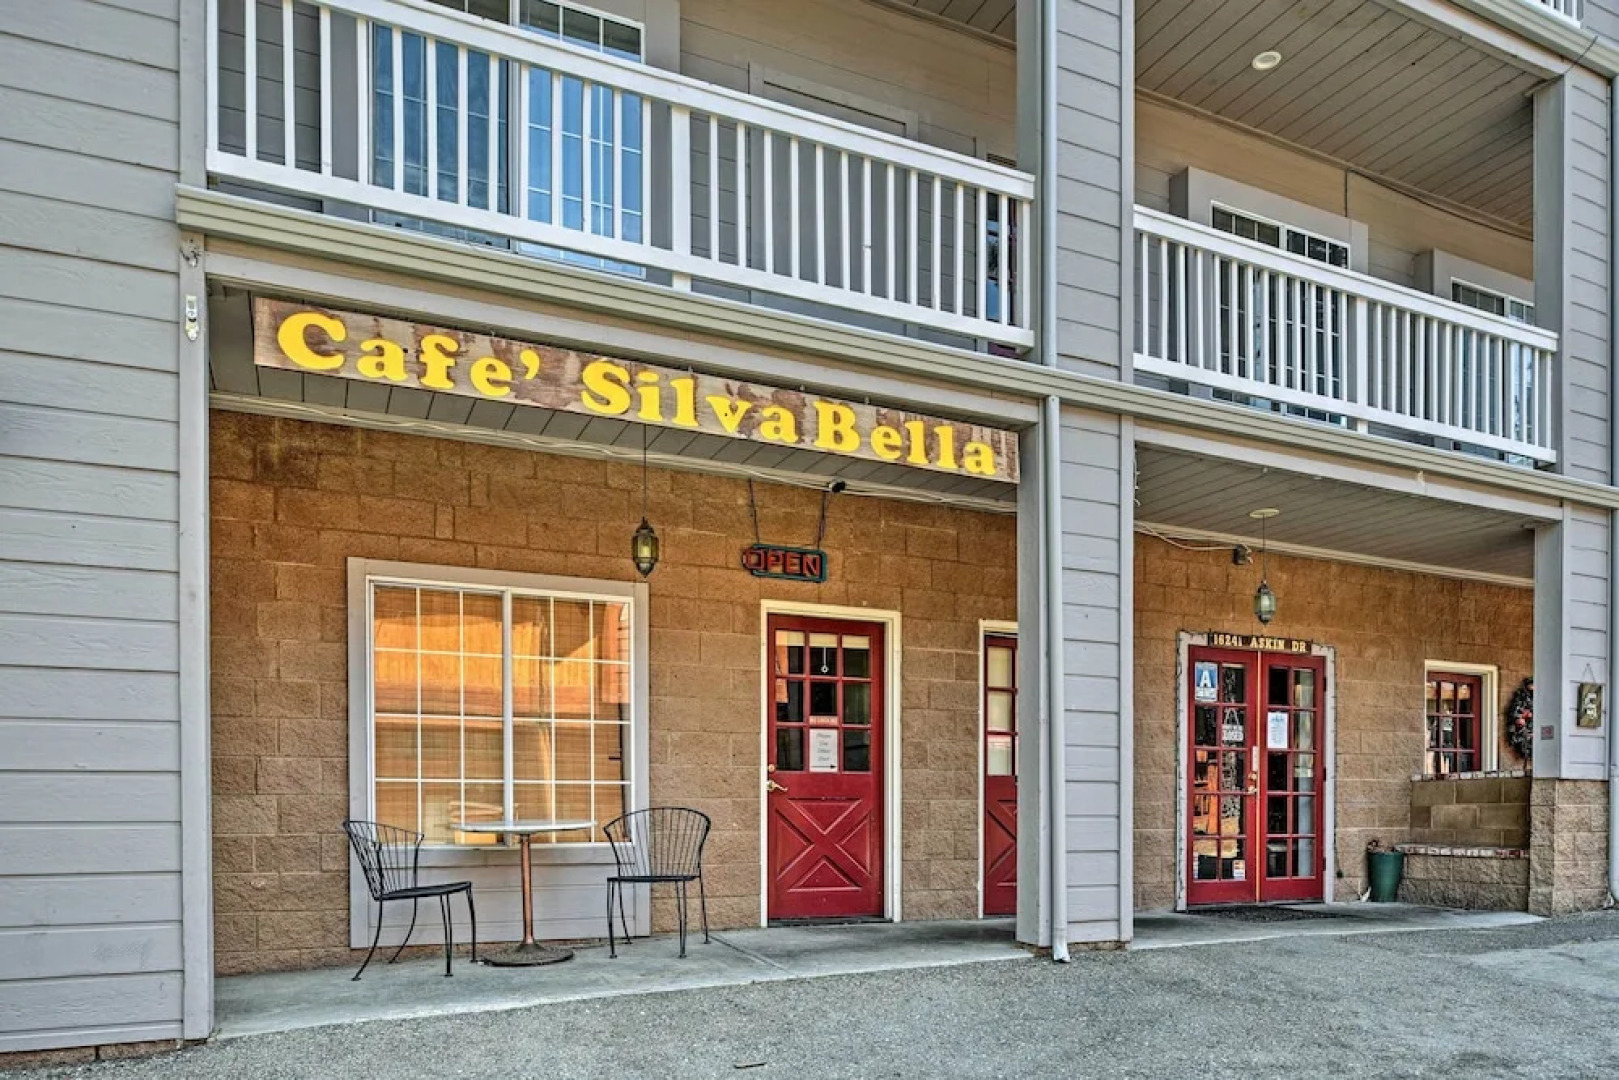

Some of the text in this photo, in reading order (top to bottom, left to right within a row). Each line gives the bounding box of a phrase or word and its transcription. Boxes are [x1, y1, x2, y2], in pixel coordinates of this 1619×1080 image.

[742, 547, 821, 577] OPEN
[1250, 636, 1285, 650] ASKIN
[1199, 669, 1212, 688] A
